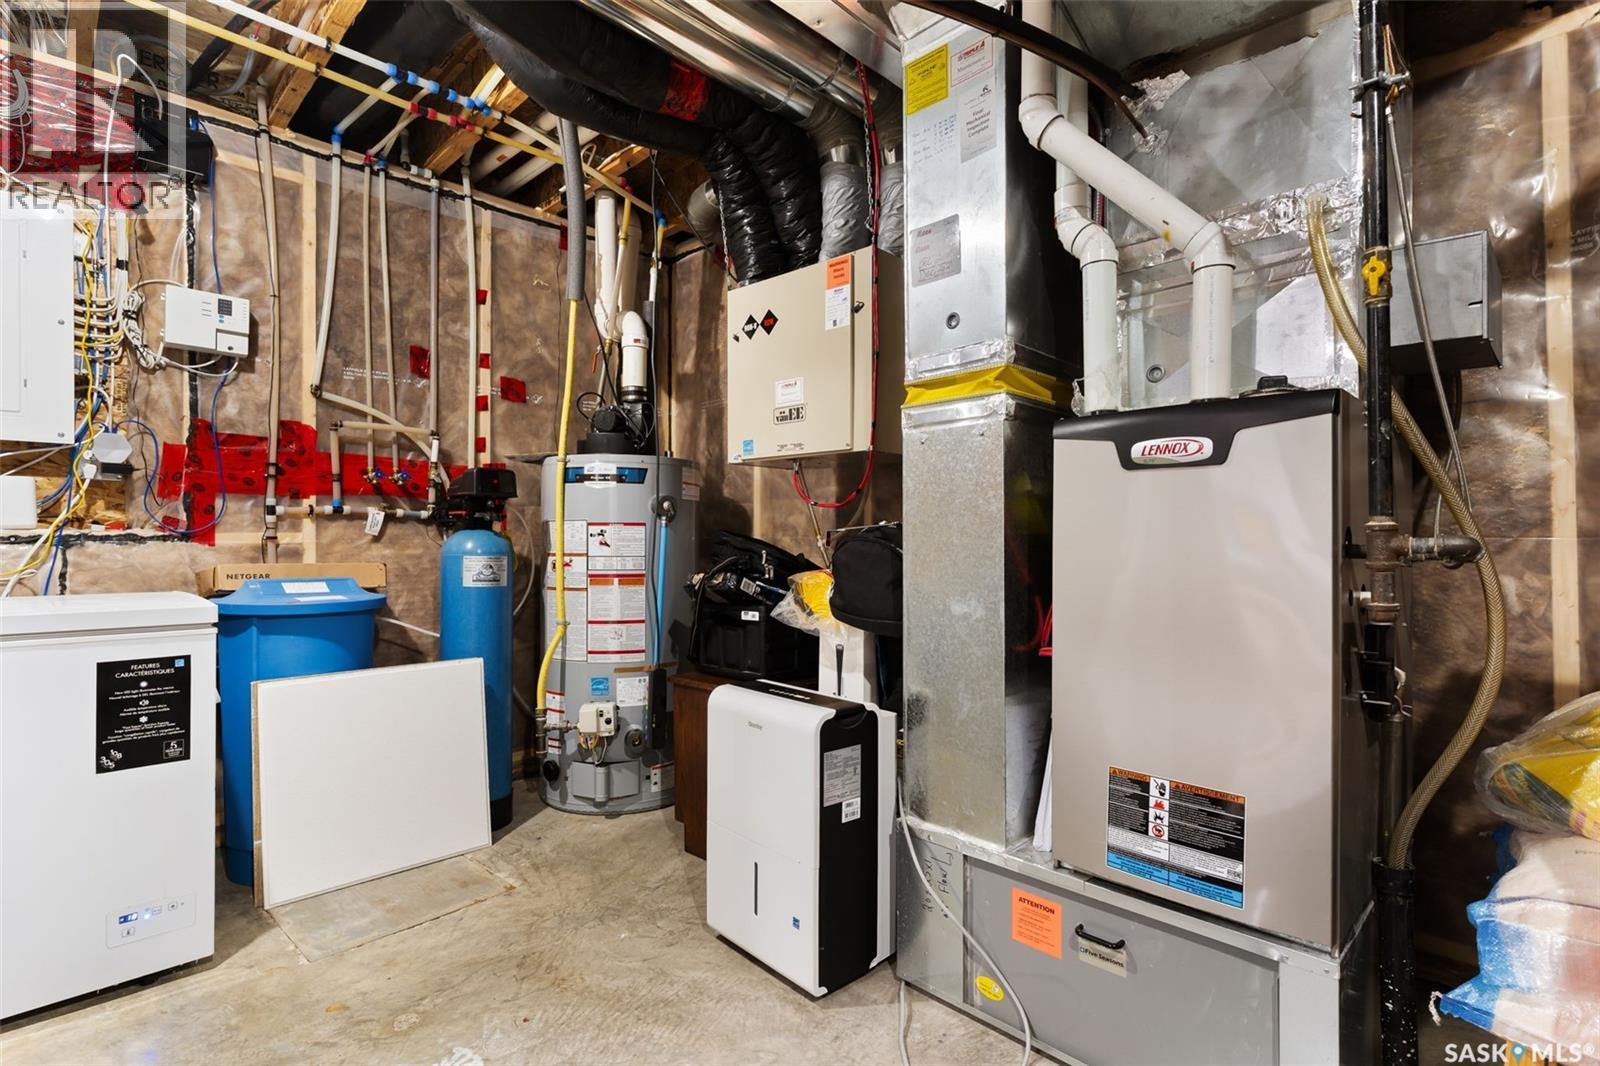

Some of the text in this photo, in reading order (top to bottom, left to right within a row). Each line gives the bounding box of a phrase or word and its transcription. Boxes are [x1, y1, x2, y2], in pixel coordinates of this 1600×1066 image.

[1141, 442, 1191, 457] LENNOX
[131, 662, 160, 670] FEATURES
[115, 668, 175, 679] CARACTÉRISTIQUES
[1018, 896, 1056, 915] ATTENTION
